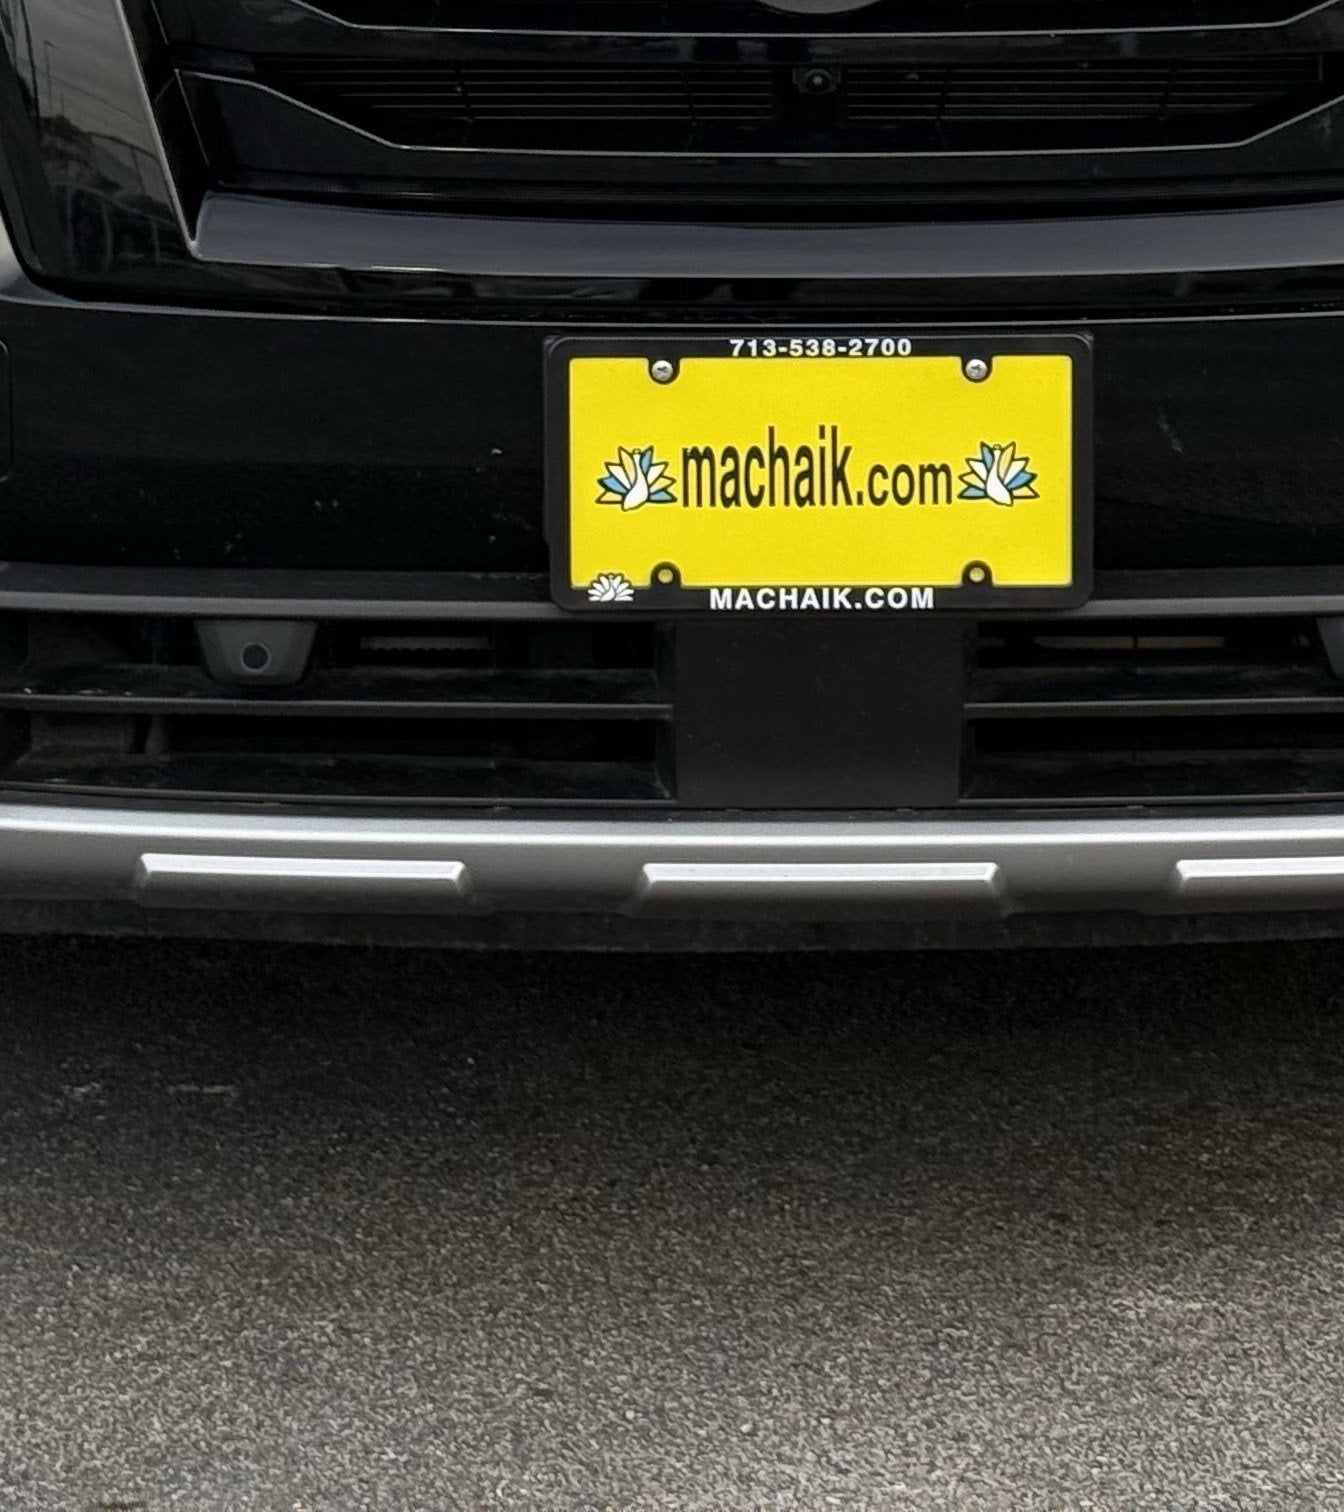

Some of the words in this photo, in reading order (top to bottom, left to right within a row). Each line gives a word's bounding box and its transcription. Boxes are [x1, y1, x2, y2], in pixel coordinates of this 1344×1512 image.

[729, 338, 913, 357] 713-538-2700
[681, 425, 953, 508] machaik.com
[709, 587, 935, 610] MACHAIK.COM
